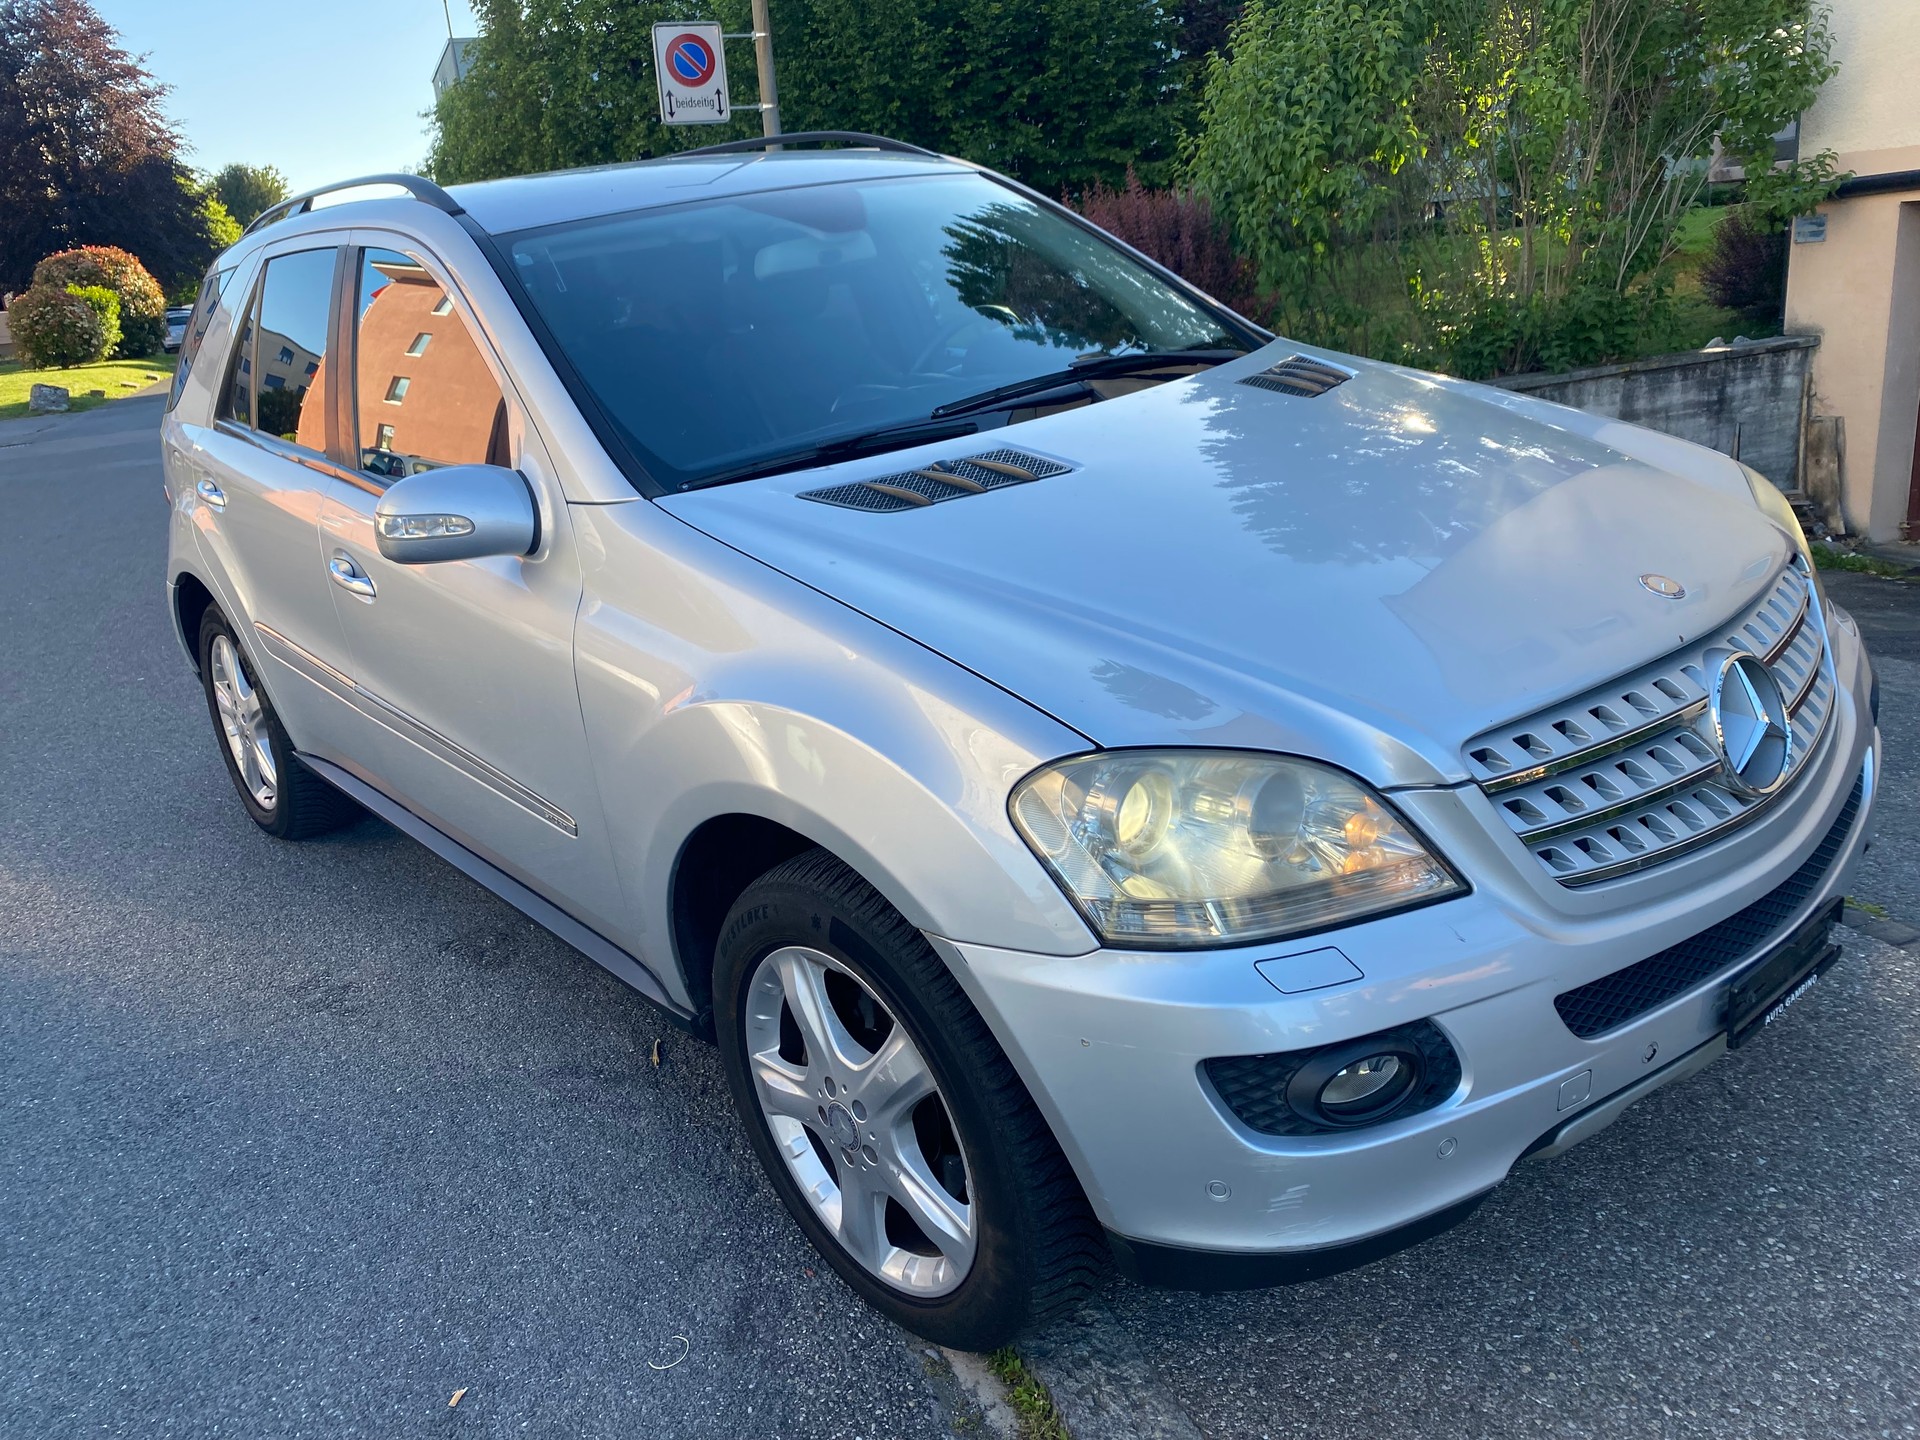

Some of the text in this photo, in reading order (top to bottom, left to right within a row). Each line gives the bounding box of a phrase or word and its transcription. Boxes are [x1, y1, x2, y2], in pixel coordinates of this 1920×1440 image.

[675, 96, 715, 110] beidseitig
[720, 903, 769, 959] WESTLAKE
[1765, 1003, 1784, 1026] AUTO
